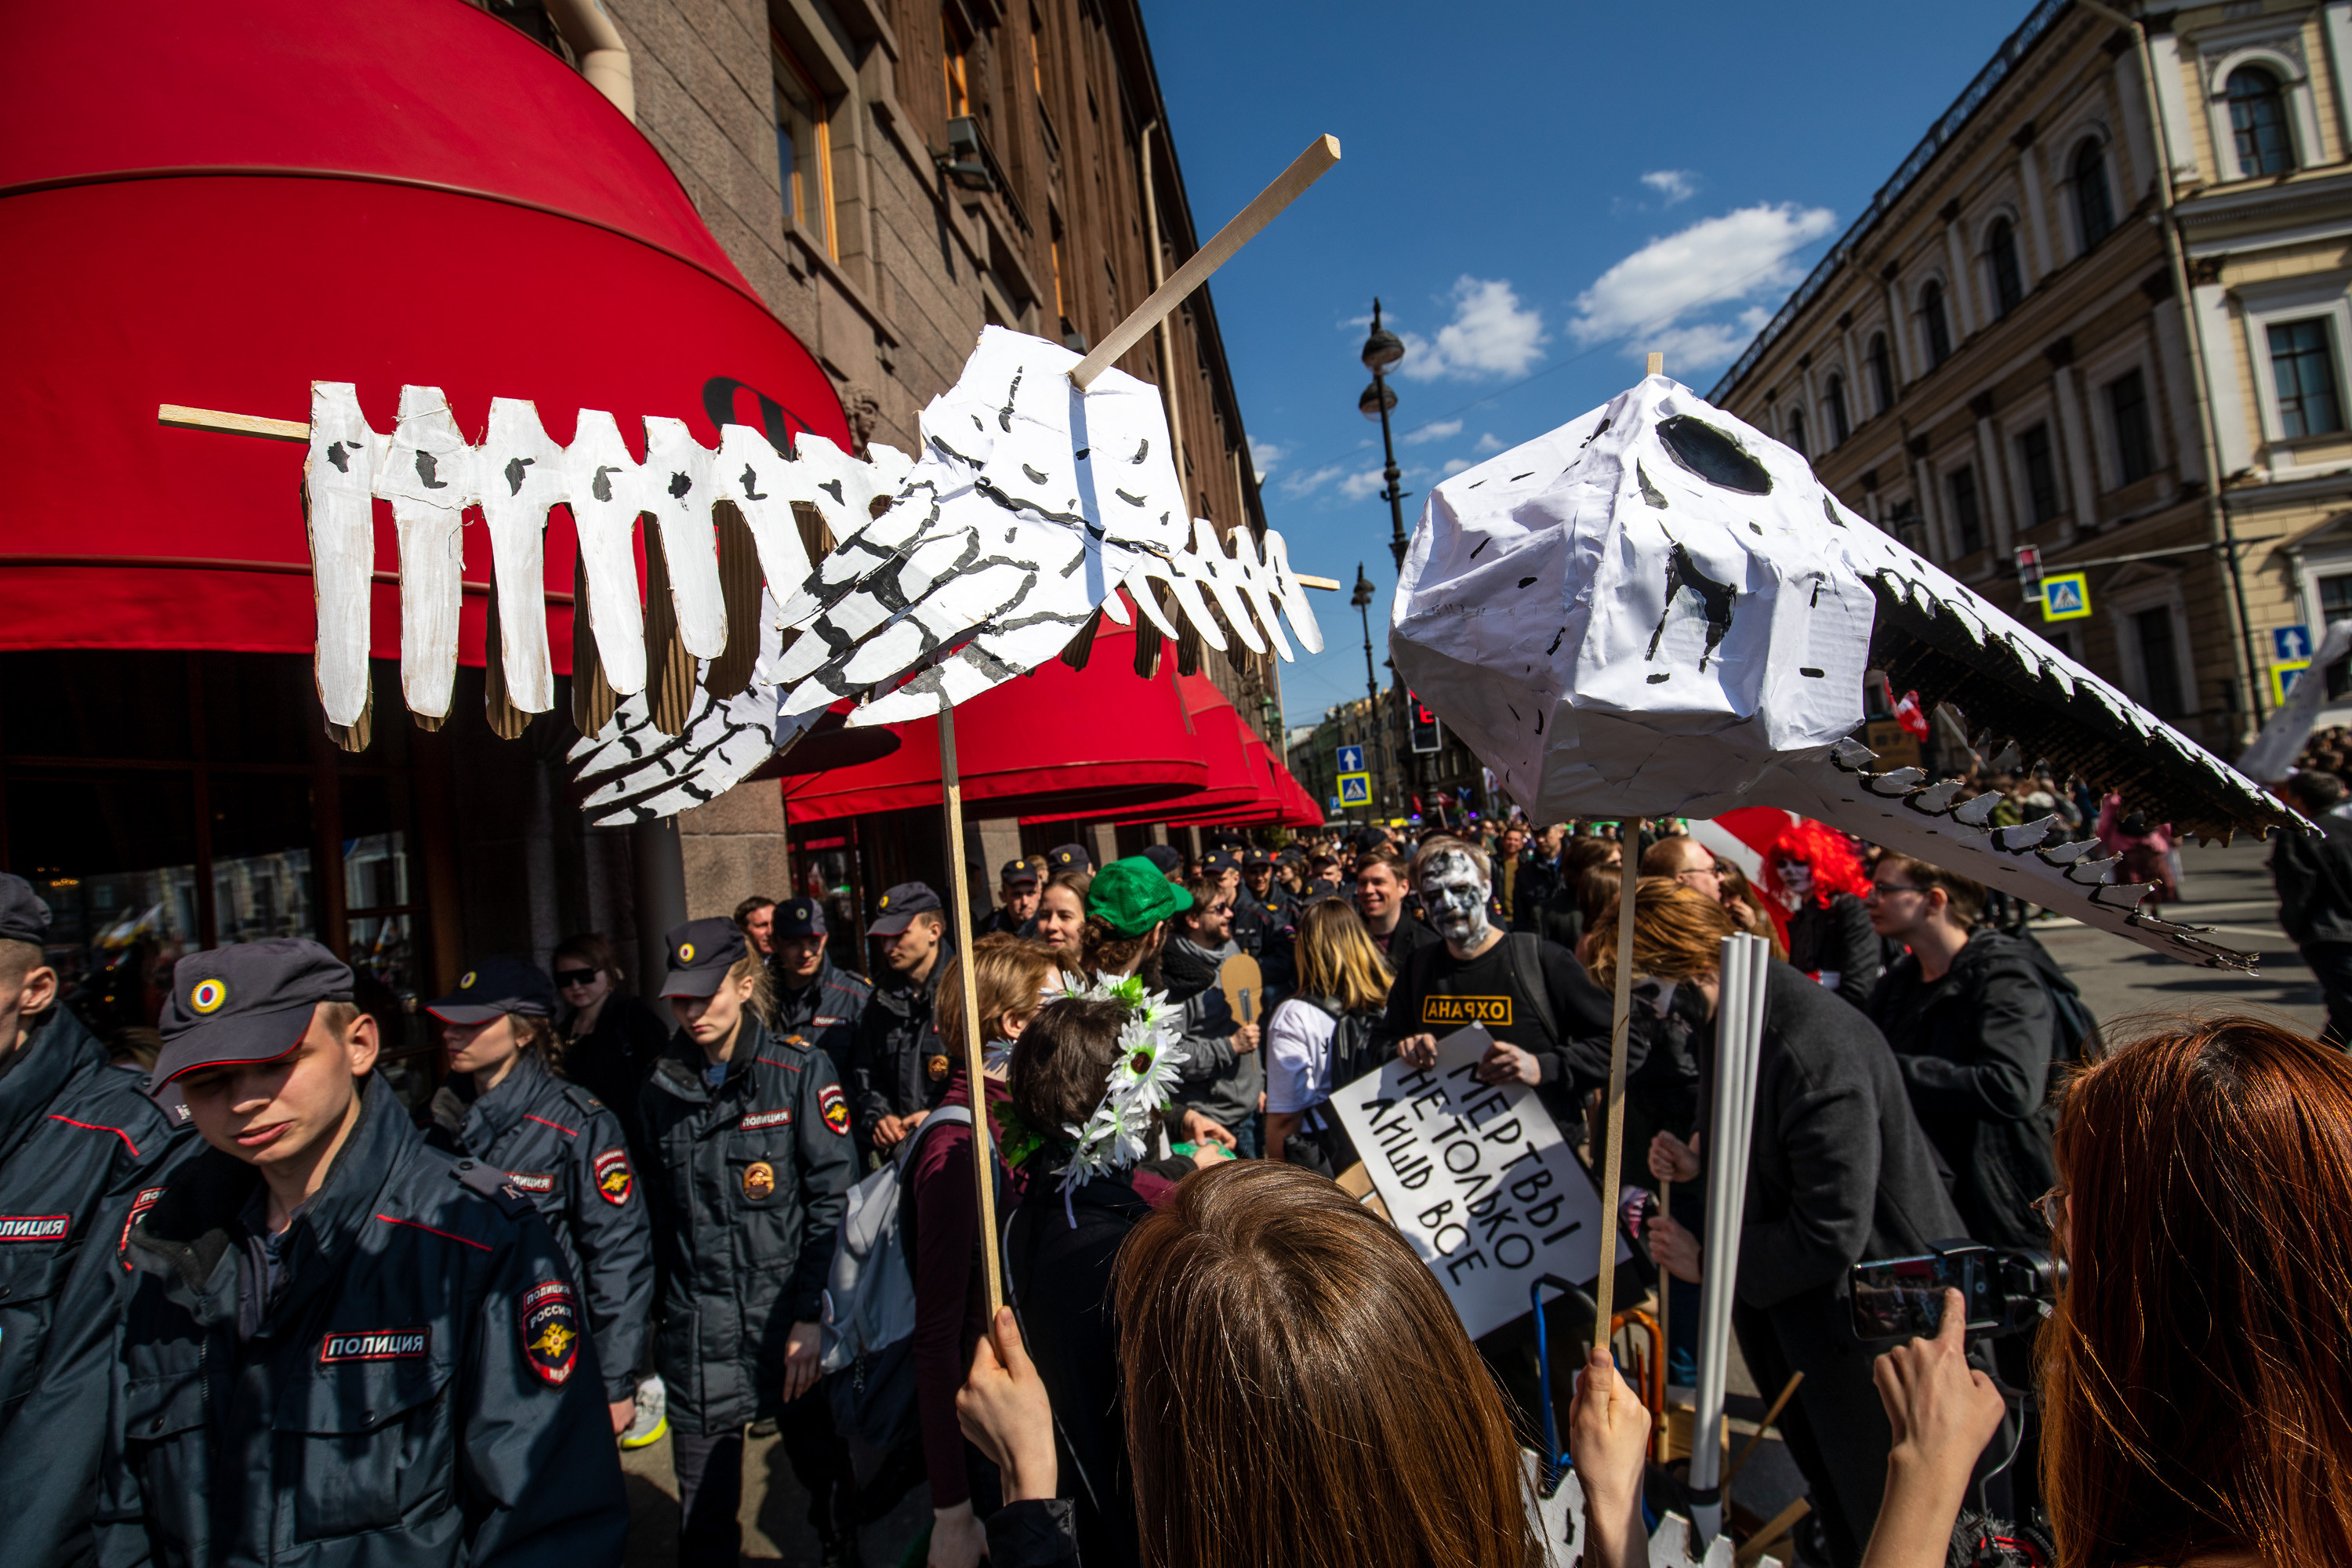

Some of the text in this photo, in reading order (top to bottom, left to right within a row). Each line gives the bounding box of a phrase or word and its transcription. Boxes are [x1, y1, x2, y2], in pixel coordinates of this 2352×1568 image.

[742, 1111, 789, 1127] ПОЛИЦИЯ
[1447, 1061, 1582, 1247] МЕРТВЫ
[1397, 1069, 1535, 1270] НЕ ТОЛЬКО
[1361, 1097, 1489, 1287] ЛИШЬ ВСЕ
[526, 1283, 571, 1305] ПОЛИЦИЯ
[529, 1305, 572, 1329] РОССИЯ
[328, 1335, 425, 1356] ПОЛИЦИЯ
[550, 1363, 570, 1382] МВД
